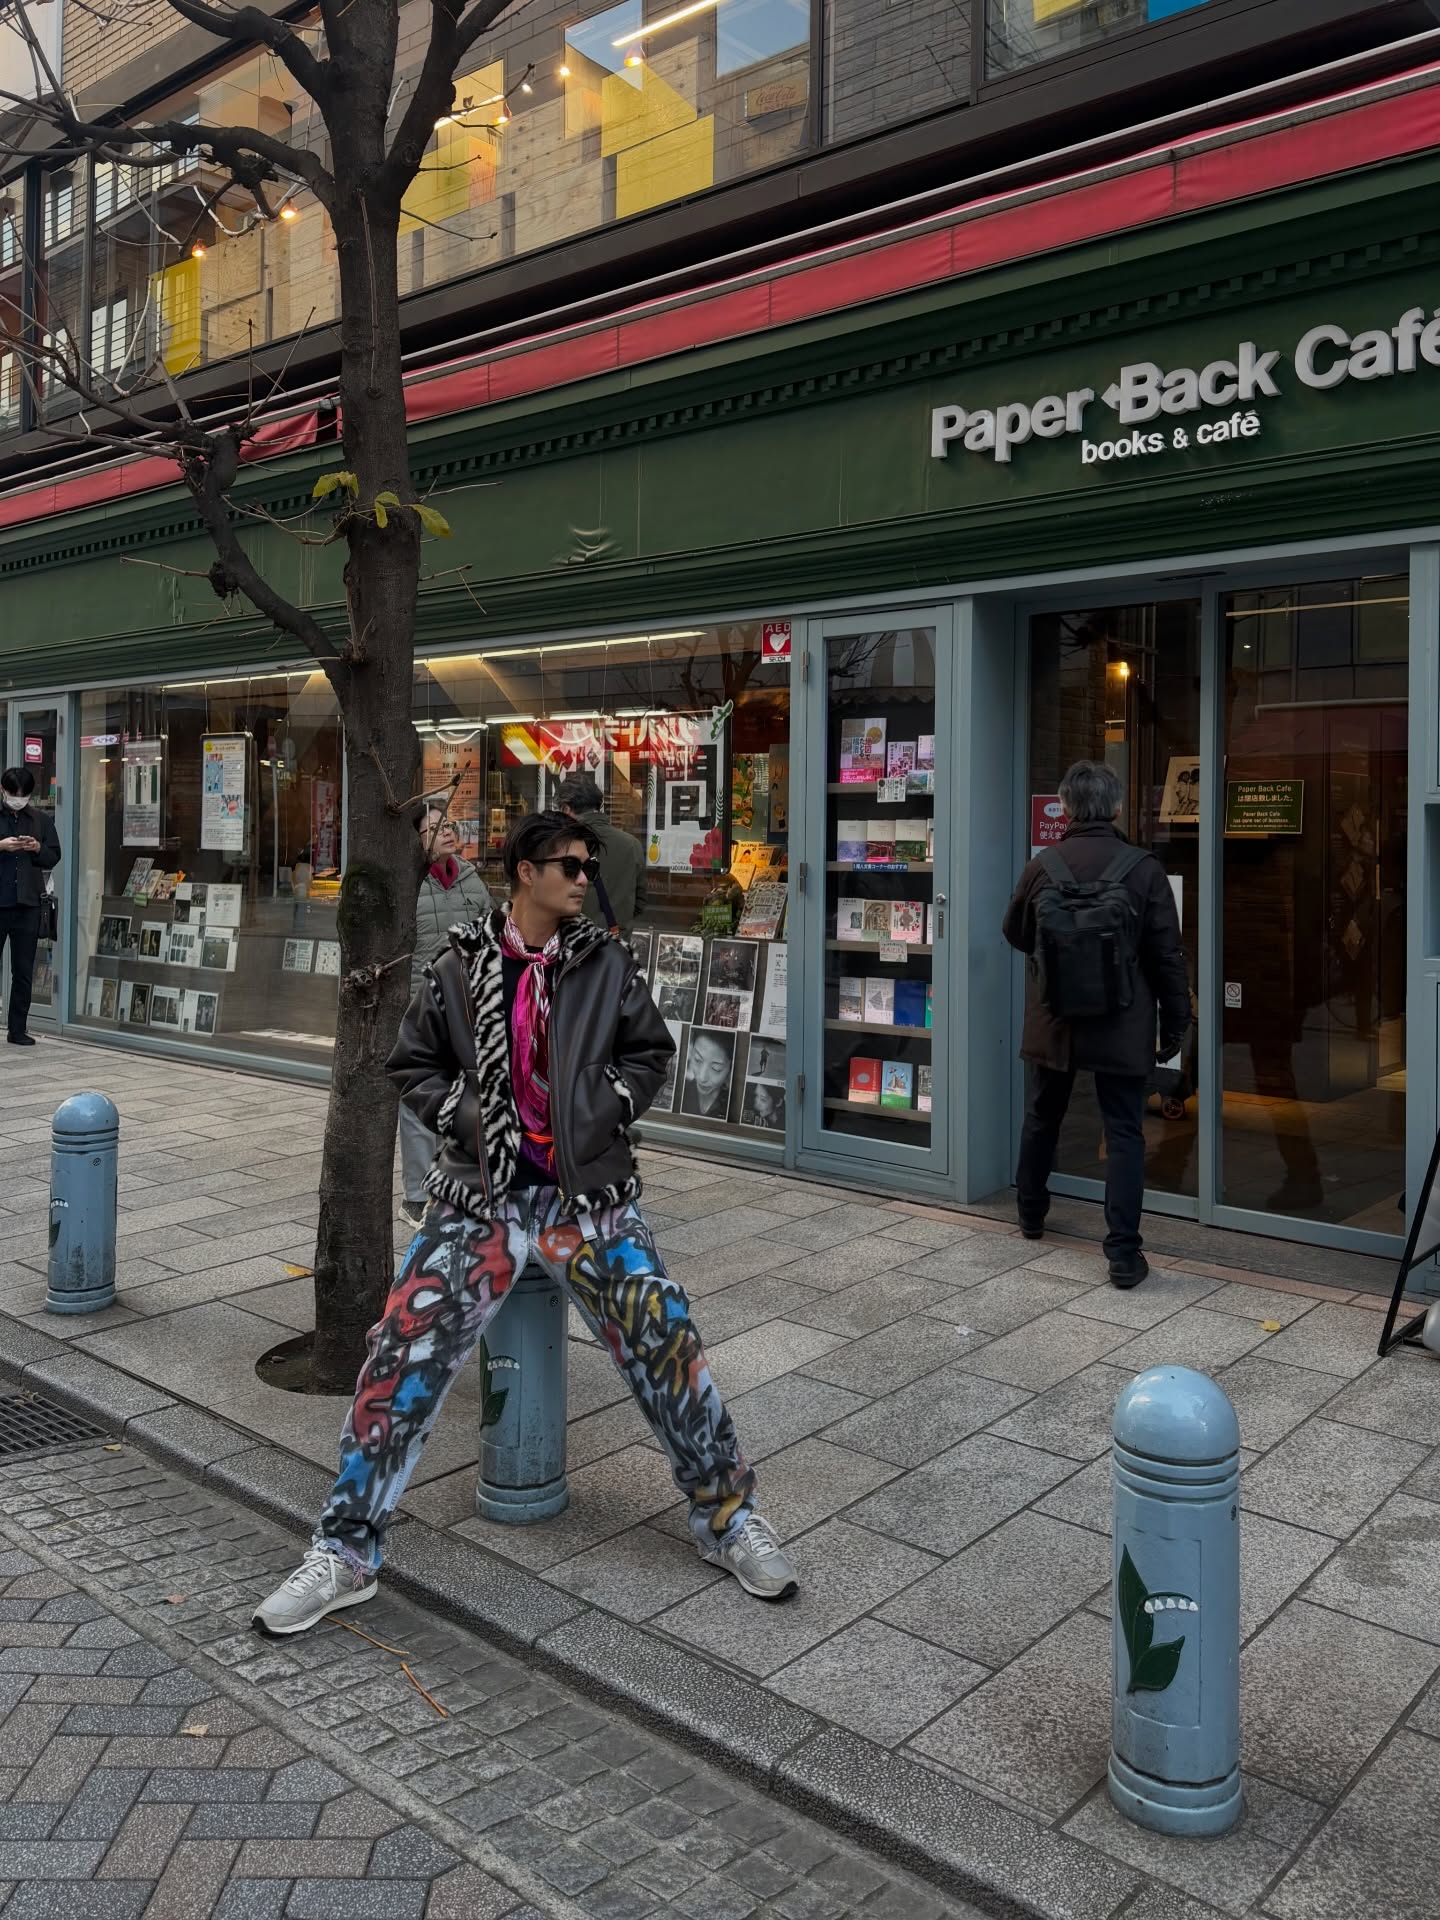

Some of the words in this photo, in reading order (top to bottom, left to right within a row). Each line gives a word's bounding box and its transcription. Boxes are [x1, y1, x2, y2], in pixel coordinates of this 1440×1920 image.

[931, 387, 1094, 463] Paper
[1119, 341, 1282, 426] Back
[1081, 430, 1166, 464] books
[1172, 427, 1189, 449] &
[1196, 409, 1261, 445] café
[765, 622, 791, 633] AED
[1238, 785, 1257, 793] Paper
[1258, 784, 1274, 792] Back
[1039, 831, 1065, 840] 使えま
